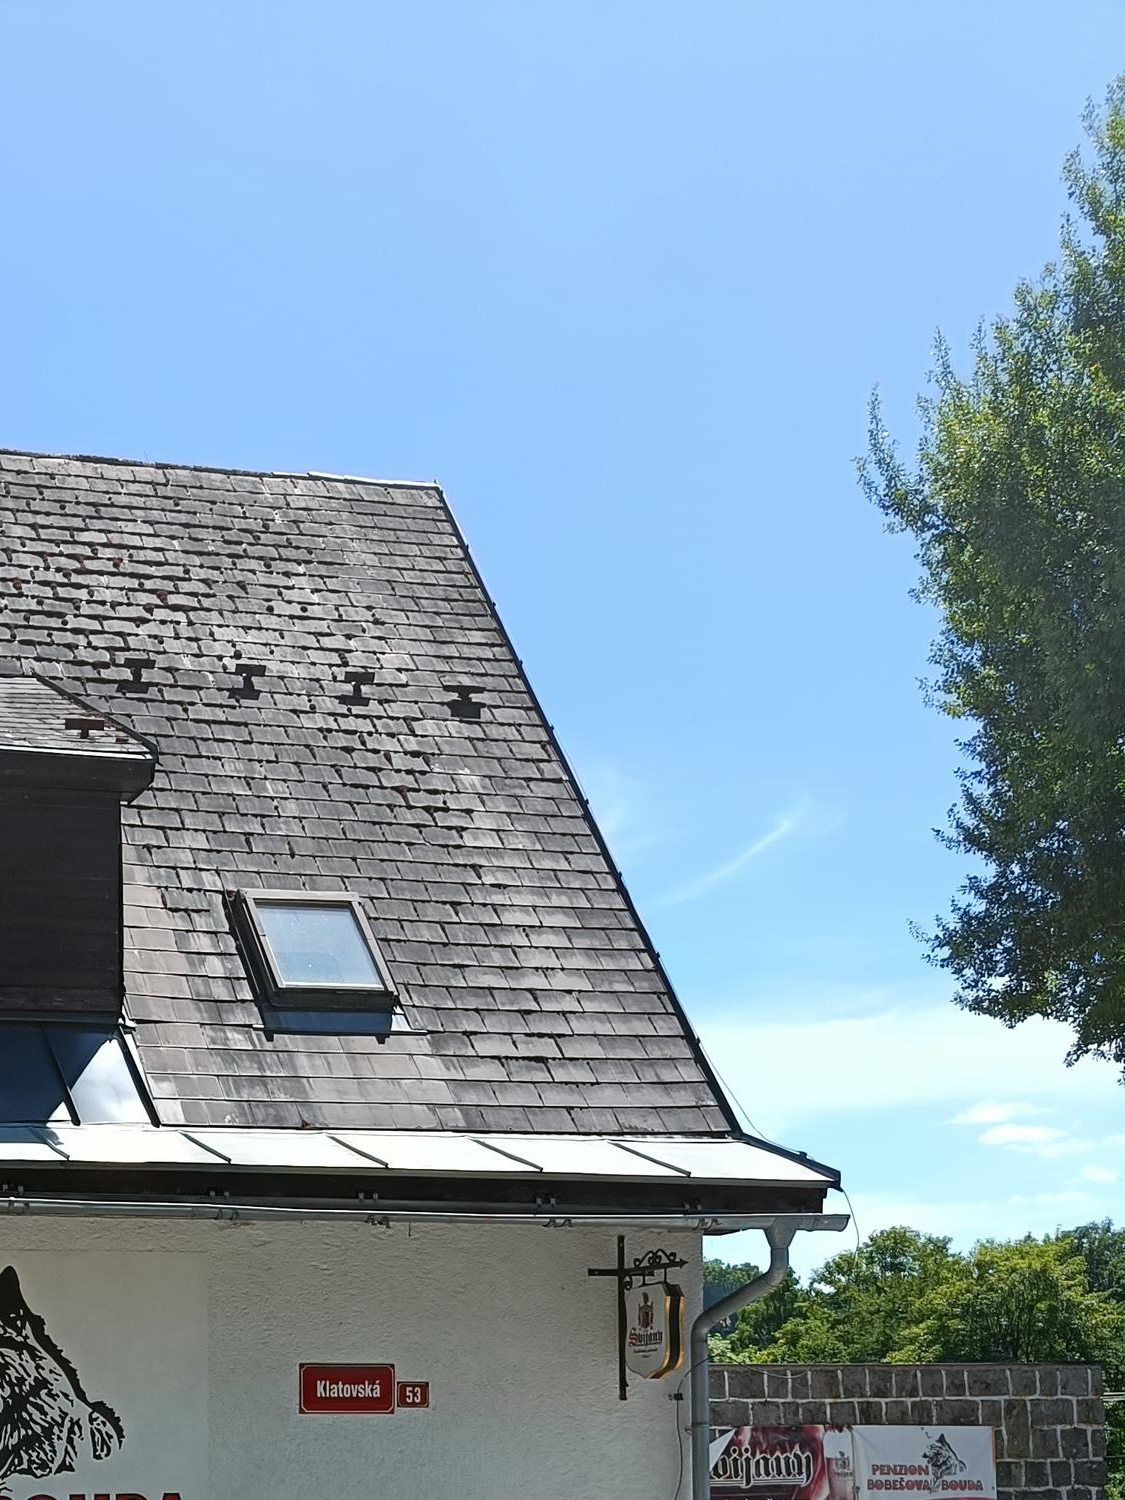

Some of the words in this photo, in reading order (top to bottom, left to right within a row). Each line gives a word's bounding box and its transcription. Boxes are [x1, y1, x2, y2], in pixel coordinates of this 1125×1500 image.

[316, 1380, 381, 1398] Klatovská
[405, 1387, 422, 1403] 53
[871, 1464, 930, 1476] PENZION
[866, 1477, 932, 1491] BOBEŠOVA
[941, 1479, 984, 1491] BOUDA
